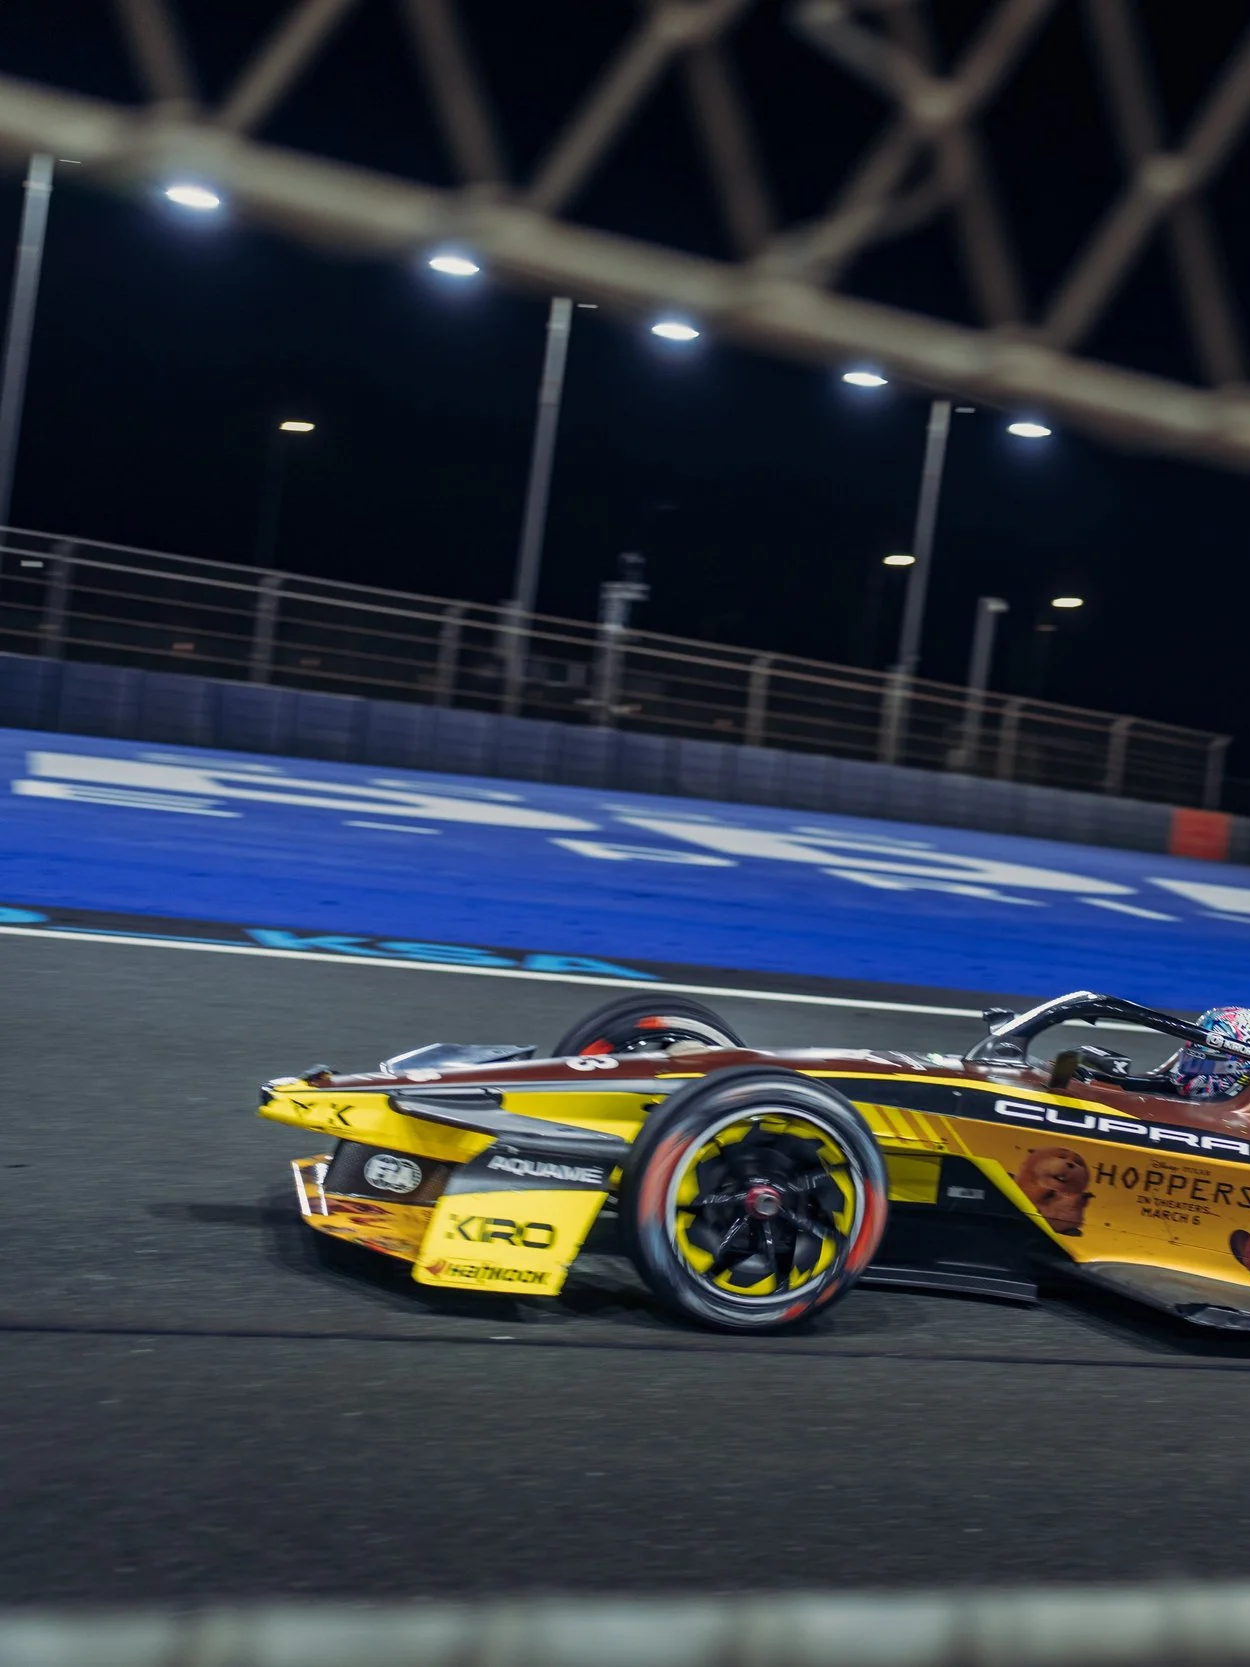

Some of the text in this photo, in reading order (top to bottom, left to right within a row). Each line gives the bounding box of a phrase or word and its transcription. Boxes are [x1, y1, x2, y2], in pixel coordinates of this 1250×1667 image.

[994, 1100, 1250, 1156] CUPRA
[1136, 1194, 1211, 1215] IN THEATERS
[1141, 1208, 1201, 1226] MARCH 6
